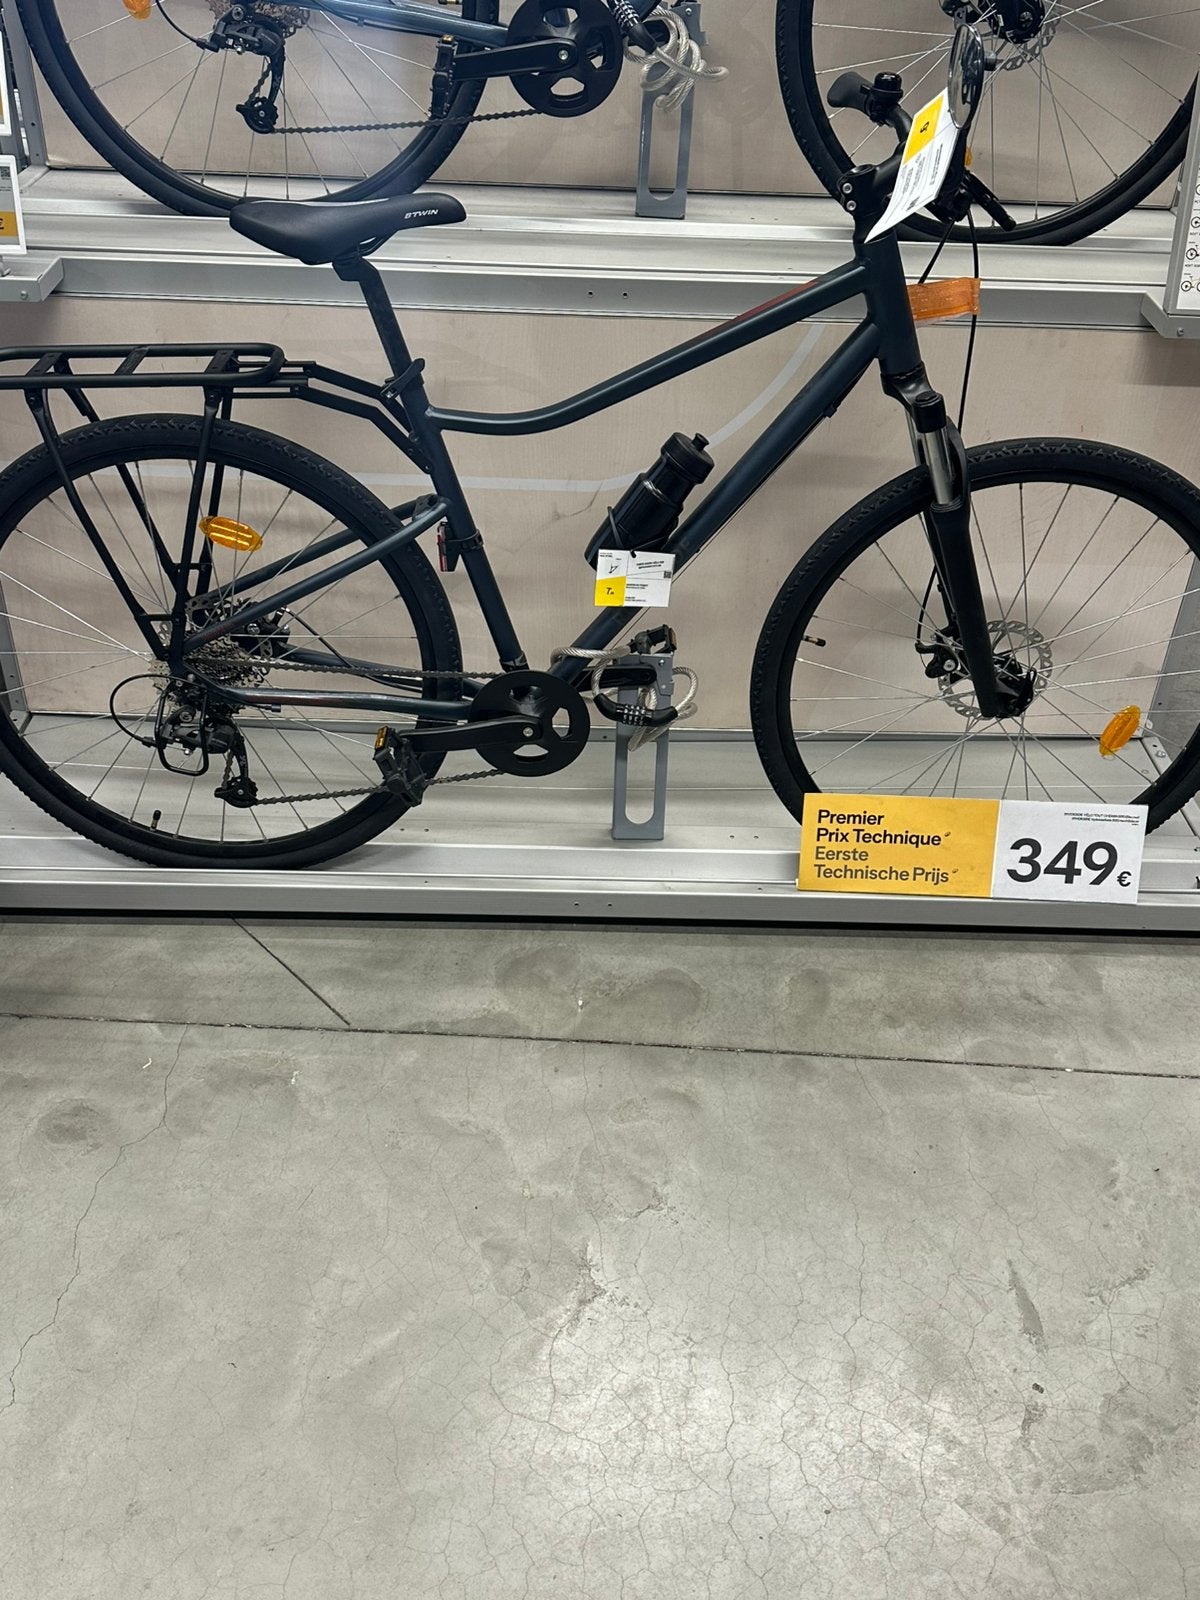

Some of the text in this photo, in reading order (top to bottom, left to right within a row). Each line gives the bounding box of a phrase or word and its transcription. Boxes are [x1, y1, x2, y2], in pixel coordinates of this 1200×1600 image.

[404, 209, 439, 219] BTWIN
[817, 809, 884, 826] Premier
[816, 827, 942, 848] Prix Technique
[815, 846, 869, 861] Eerste
[813, 863, 950, 886] Technische Prijs
